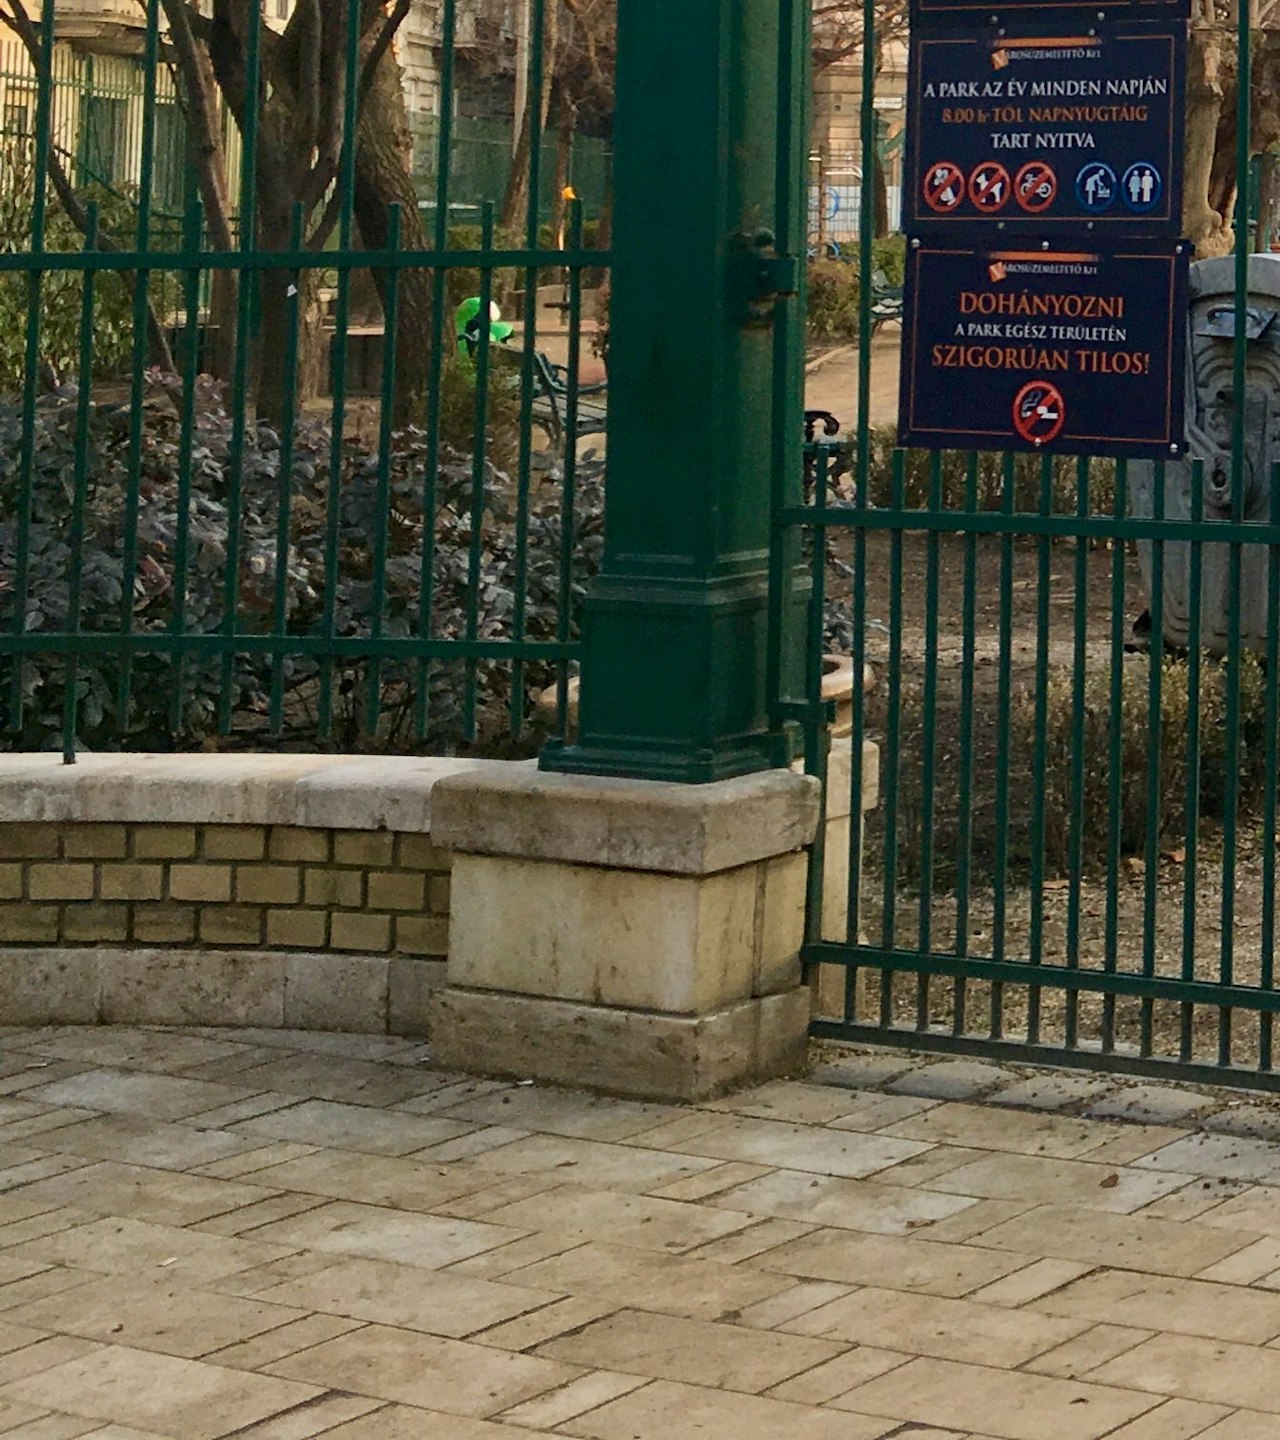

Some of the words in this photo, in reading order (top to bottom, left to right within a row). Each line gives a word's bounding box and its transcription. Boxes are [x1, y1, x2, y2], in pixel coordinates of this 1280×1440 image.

[923, 83, 936, 98] A
[939, 81, 980, 98] PARK
[981, 81, 1003, 97] AZ
[1008, 77, 1028, 97] ÉV
[1030, 79, 1101, 97] MINDEN
[1106, 75, 1167, 99] NAPJÁN
[1028, 102, 1148, 123] NAPNYUGTÁIG
[990, 132, 1031, 149] TART
[1035, 131, 1096, 149] NYITVA
[959, 288, 1125, 318] DOHÁNYOZNI
[954, 323, 965, 336] A
[967, 323, 1003, 337] PARK
[1005, 321, 1048, 339] EGÉSZ
[932, 343, 1069, 370] SZIGORÚAN
[1076, 348, 1150, 375] TILOS!
